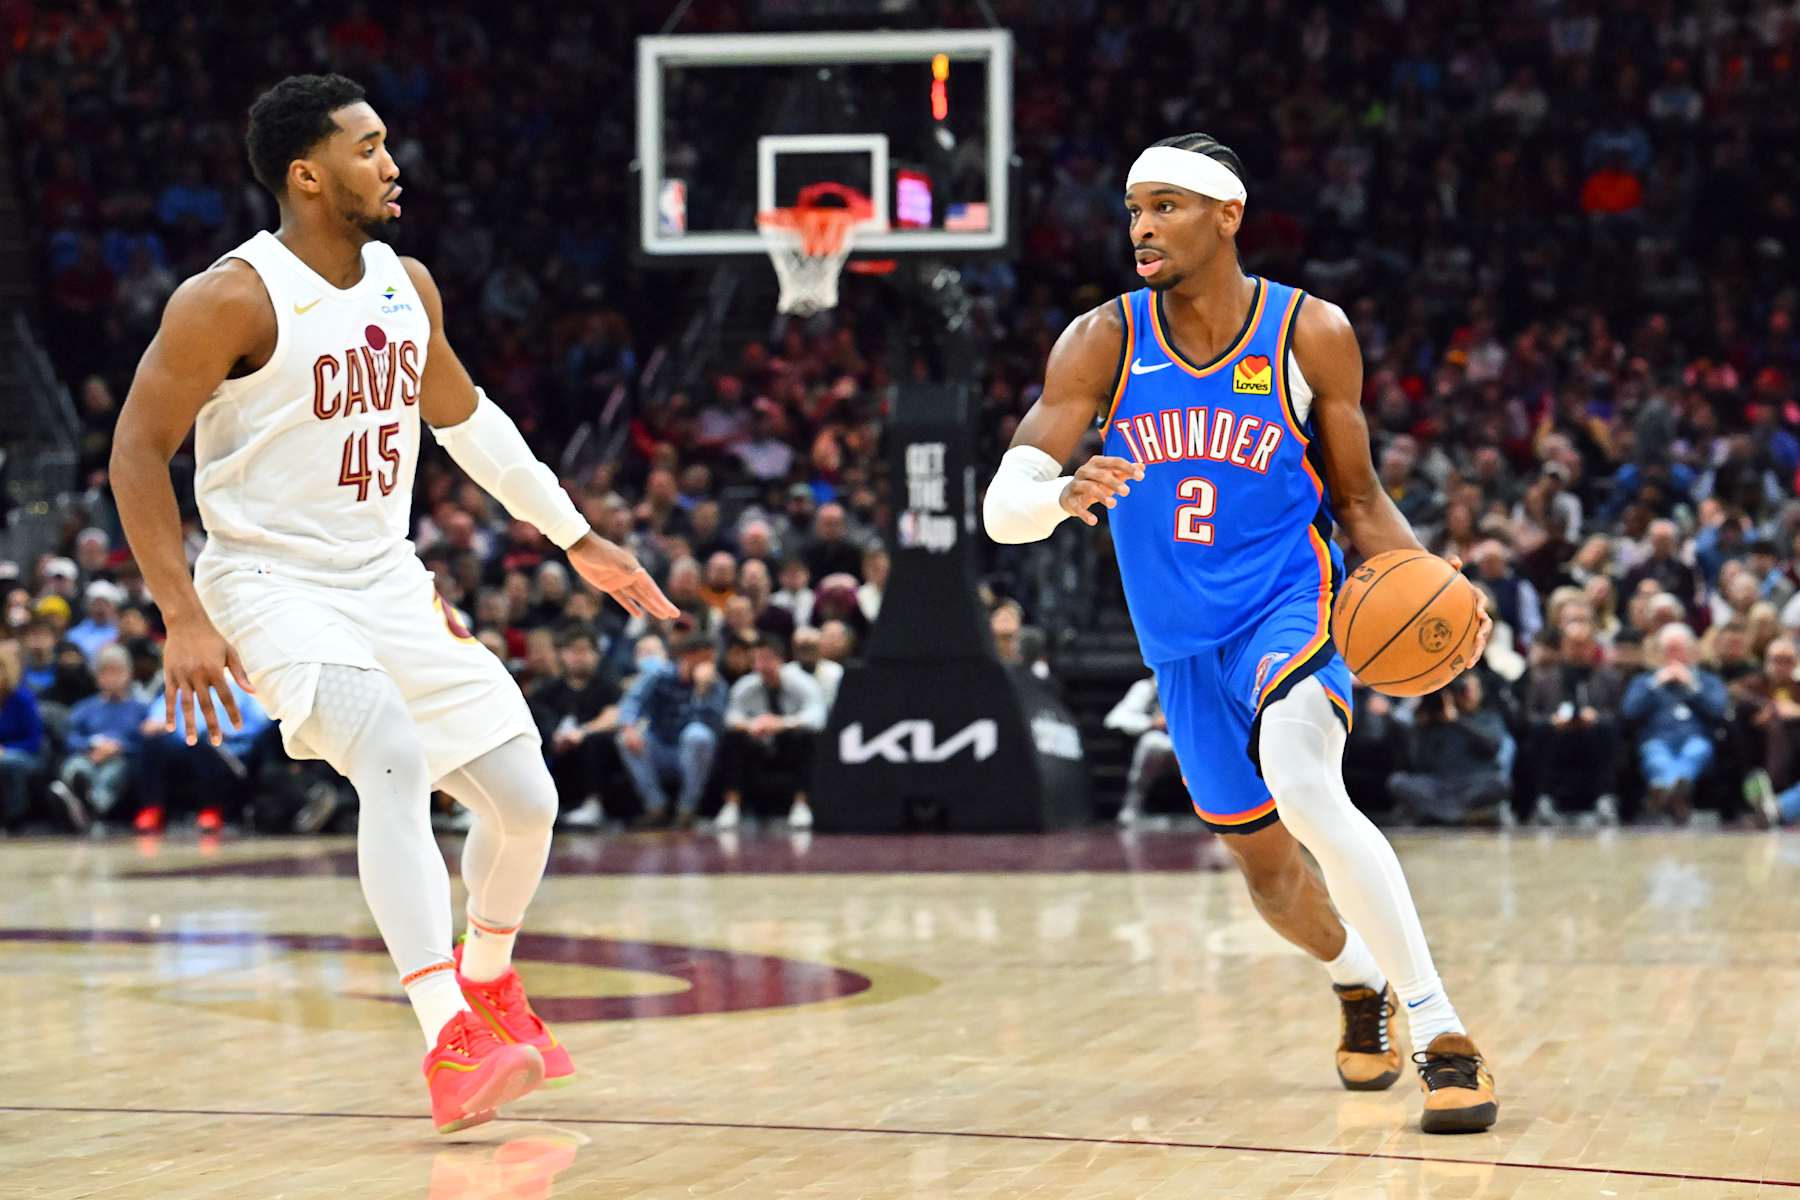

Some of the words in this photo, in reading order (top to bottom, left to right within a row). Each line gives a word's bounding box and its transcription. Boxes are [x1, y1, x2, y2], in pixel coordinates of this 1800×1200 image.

[313, 339, 420, 420] CAVS
[338, 422, 400, 502] 45
[1115, 406, 1284, 476] THUNDER
[1174, 476, 1217, 546] 2
[838, 719, 997, 764] KIA
